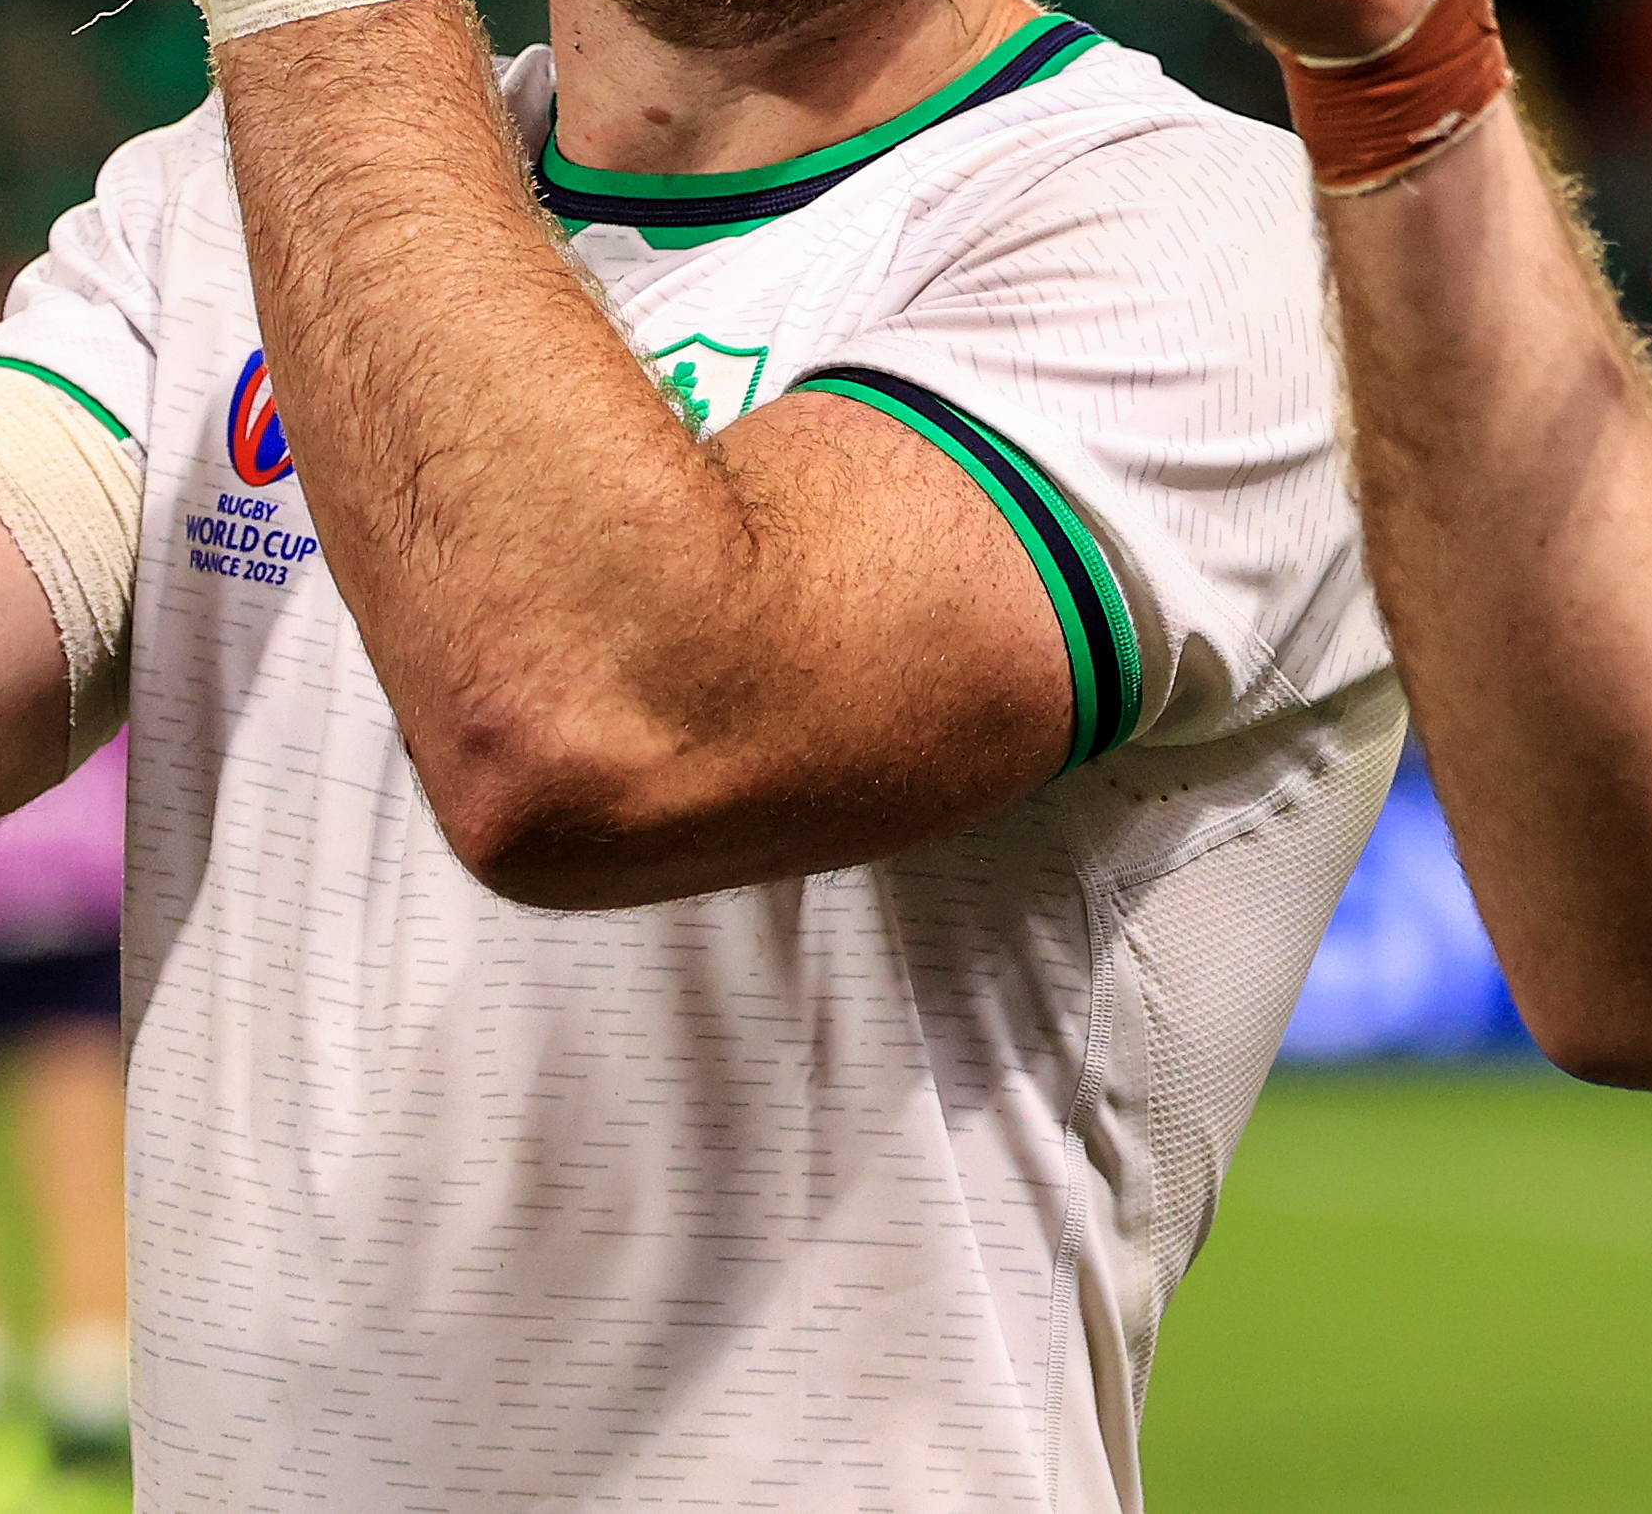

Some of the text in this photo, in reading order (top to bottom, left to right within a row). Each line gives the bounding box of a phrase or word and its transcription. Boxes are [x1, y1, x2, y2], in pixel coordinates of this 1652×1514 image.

[218, 493, 278, 522] RUGBY
[186, 514, 317, 562] WORLD CUP
[190, 549, 288, 585] FRANCE 2023
